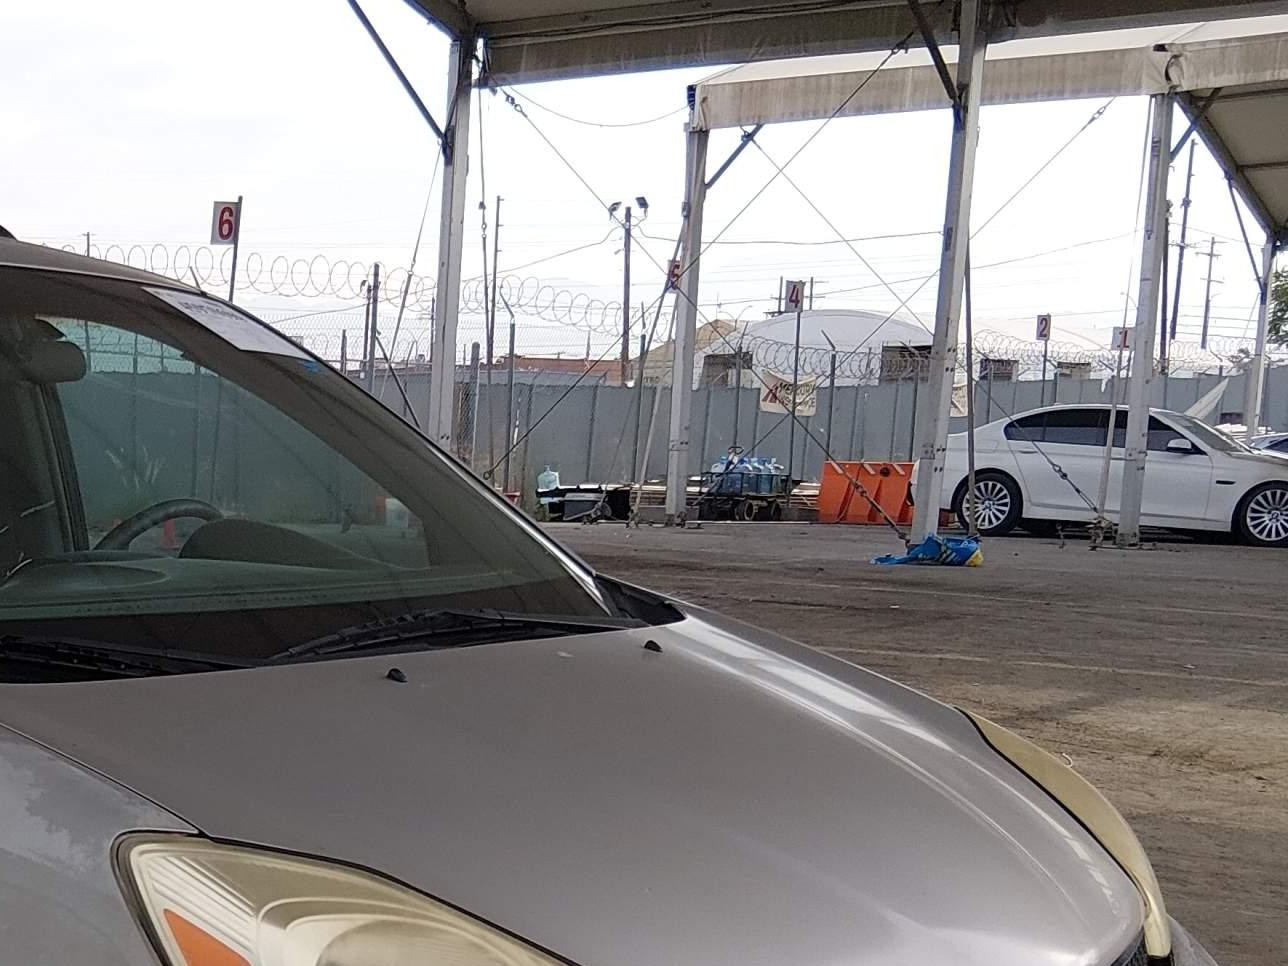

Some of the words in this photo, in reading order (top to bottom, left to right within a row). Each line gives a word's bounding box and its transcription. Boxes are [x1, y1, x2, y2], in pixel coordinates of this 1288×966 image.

[218, 206, 234, 241] 6
[788, 284, 800, 309] 4
[1038, 317, 1048, 338] 2
[1116, 329, 1130, 349] 1
